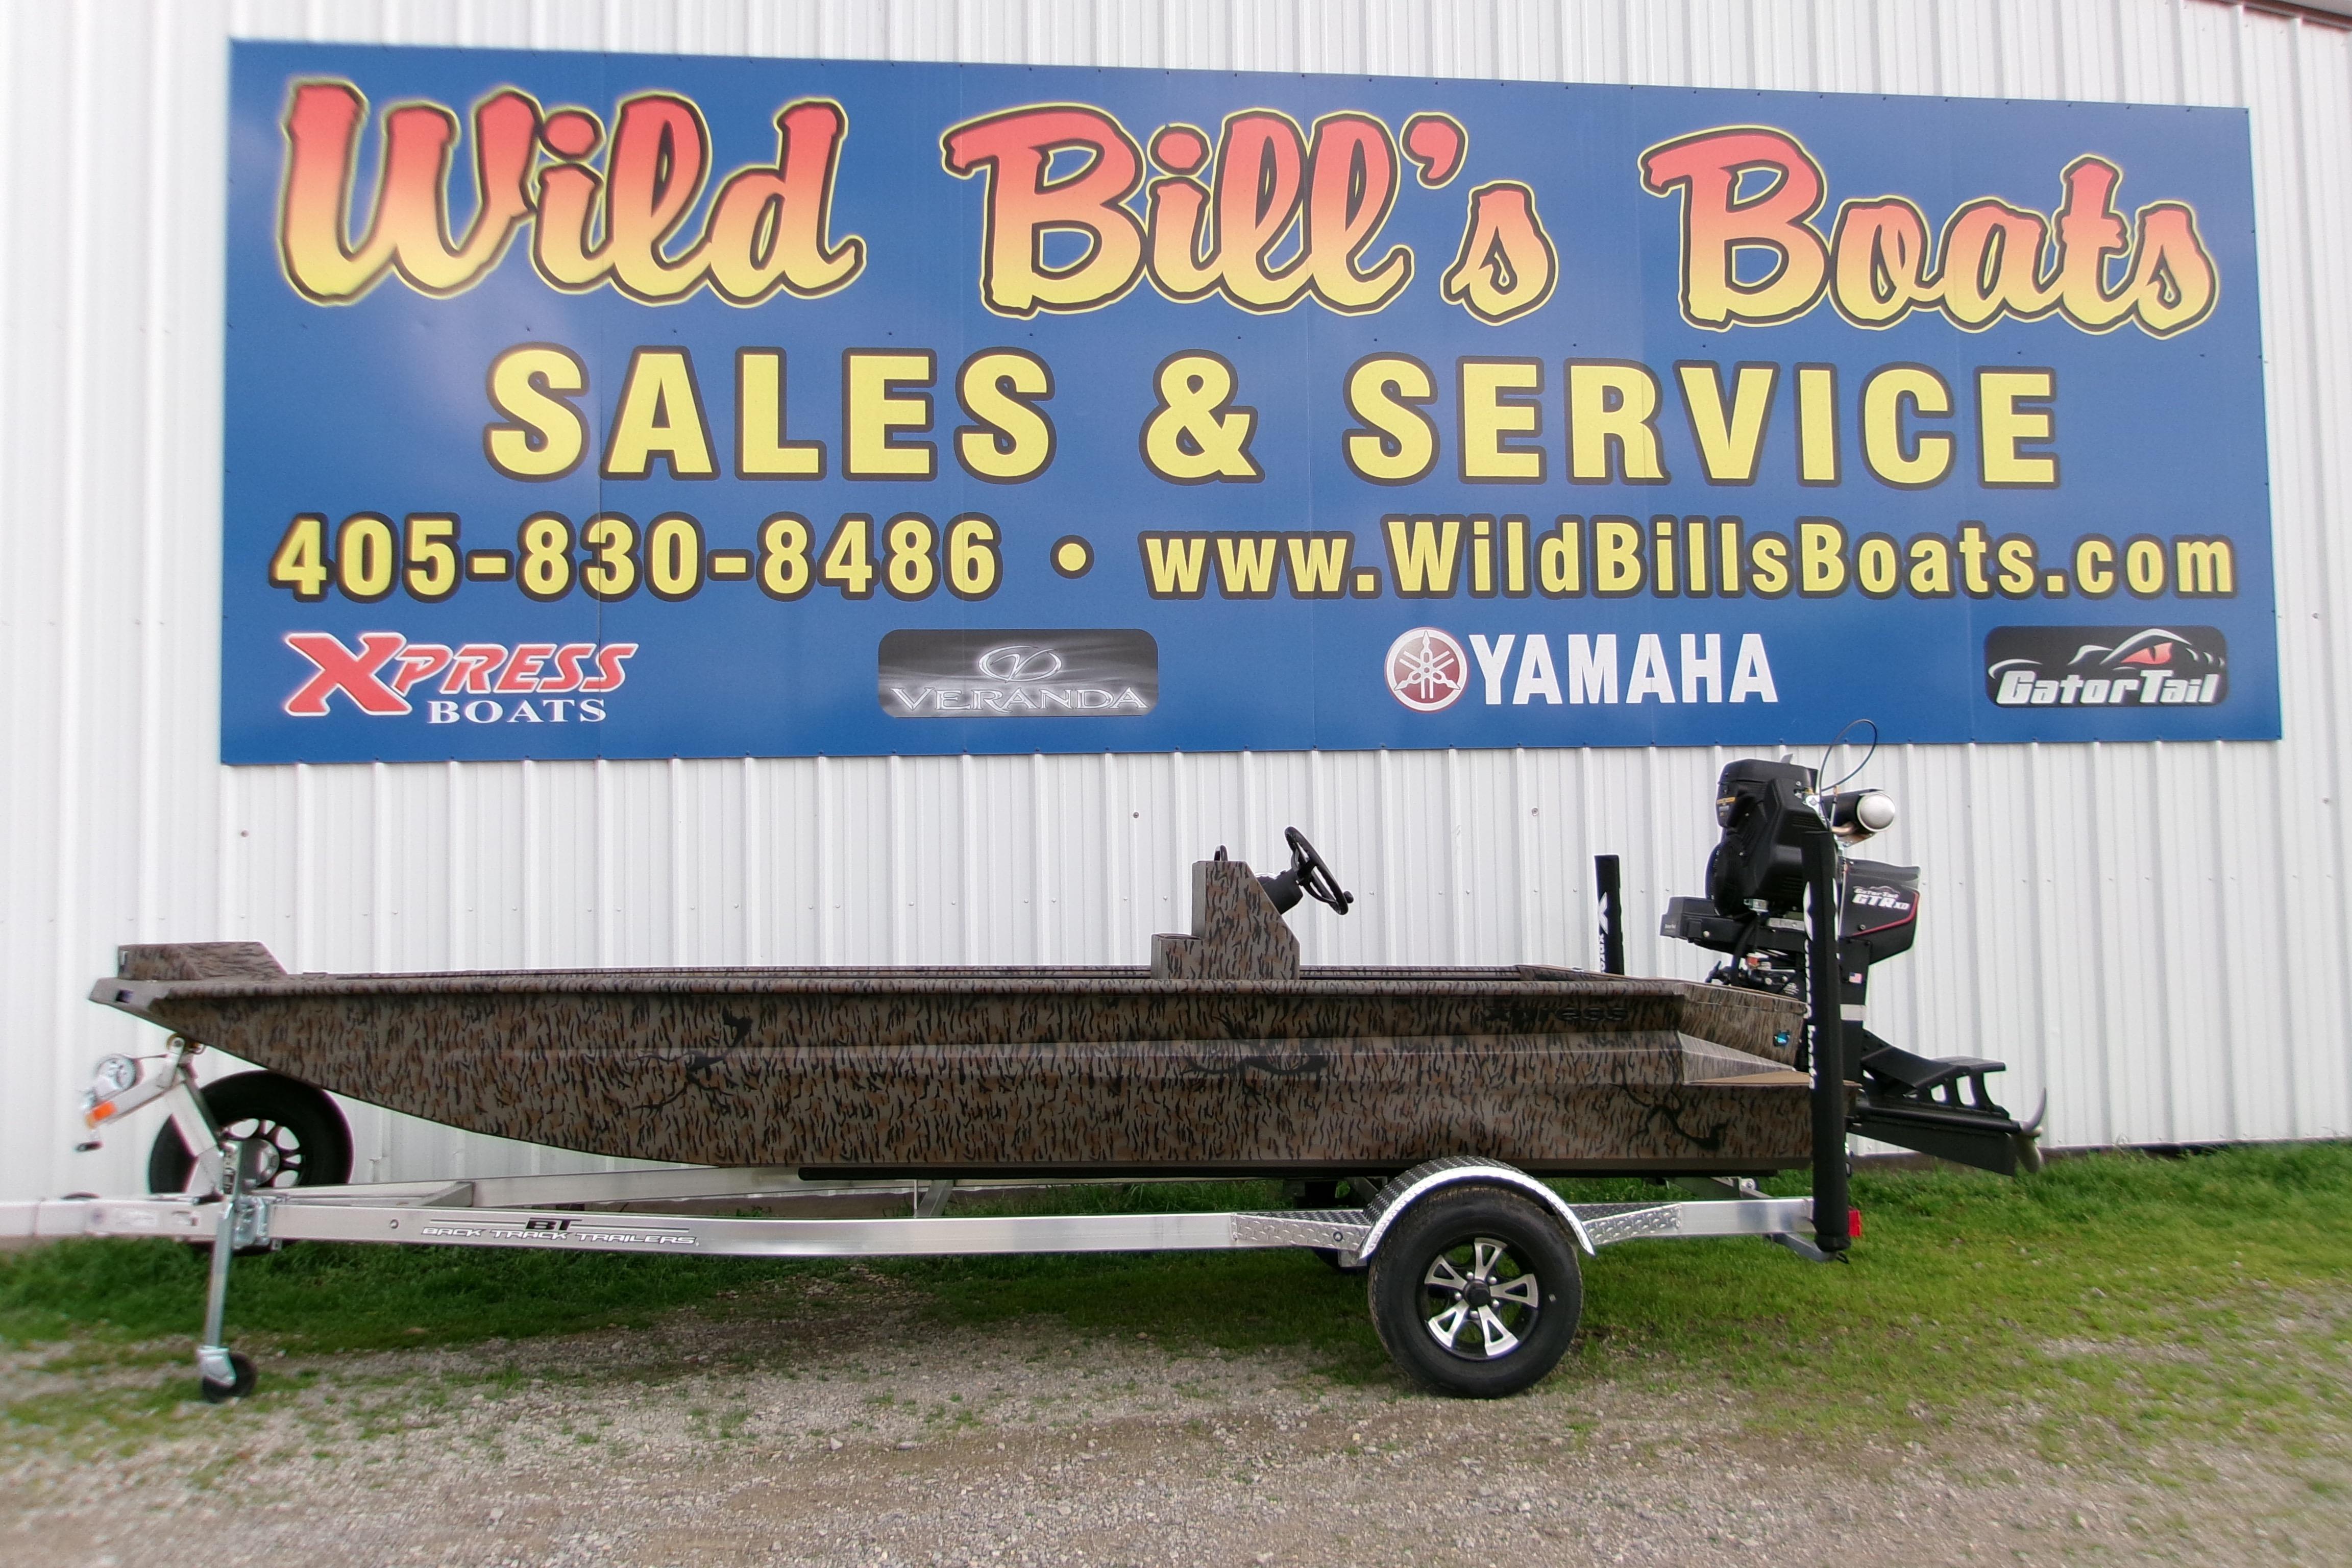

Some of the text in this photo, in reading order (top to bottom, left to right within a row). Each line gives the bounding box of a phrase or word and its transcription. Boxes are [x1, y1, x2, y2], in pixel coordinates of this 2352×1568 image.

[279, 78, 2218, 339] Wild Bill's Boats
[485, 345, 2057, 486] SALES & SERVICE
[271, 516, 2236, 598] 405-830-8486 www.WildBillsBoats.com
[284, 633, 639, 716] XPRESS
[889, 687, 1148, 713] VERANDA
[1468, 633, 1778, 705] YAMAHA
[1996, 670, 2220, 704] GatorTail
[426, 698, 607, 724] BOATS
[422, 1226, 698, 1244] BACK TRACK TRAILERS
